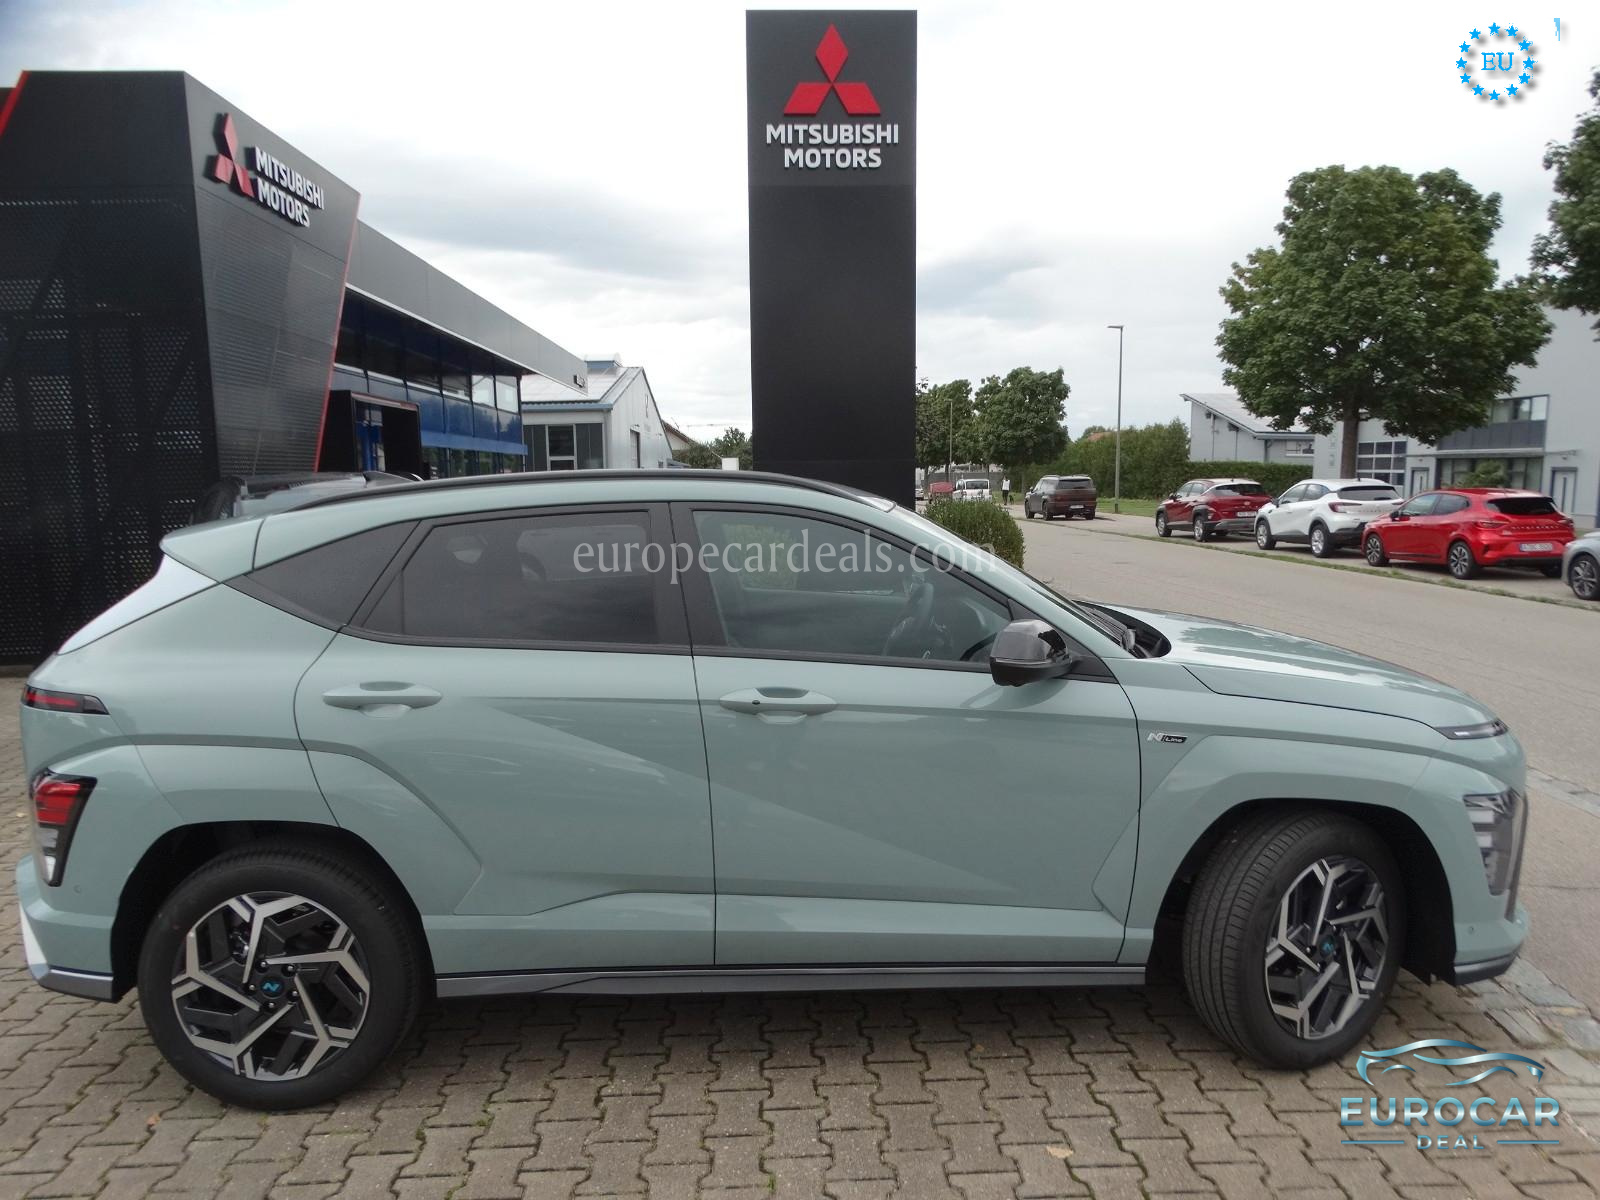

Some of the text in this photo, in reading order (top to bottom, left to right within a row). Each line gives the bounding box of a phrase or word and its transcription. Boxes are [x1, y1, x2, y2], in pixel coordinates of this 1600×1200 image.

[766, 123, 899, 145] MITSUBISHI
[784, 148, 882, 169] MOTORS
[254, 145, 325, 211] MITSUBISHI
[256, 177, 311, 228] MOTORS
